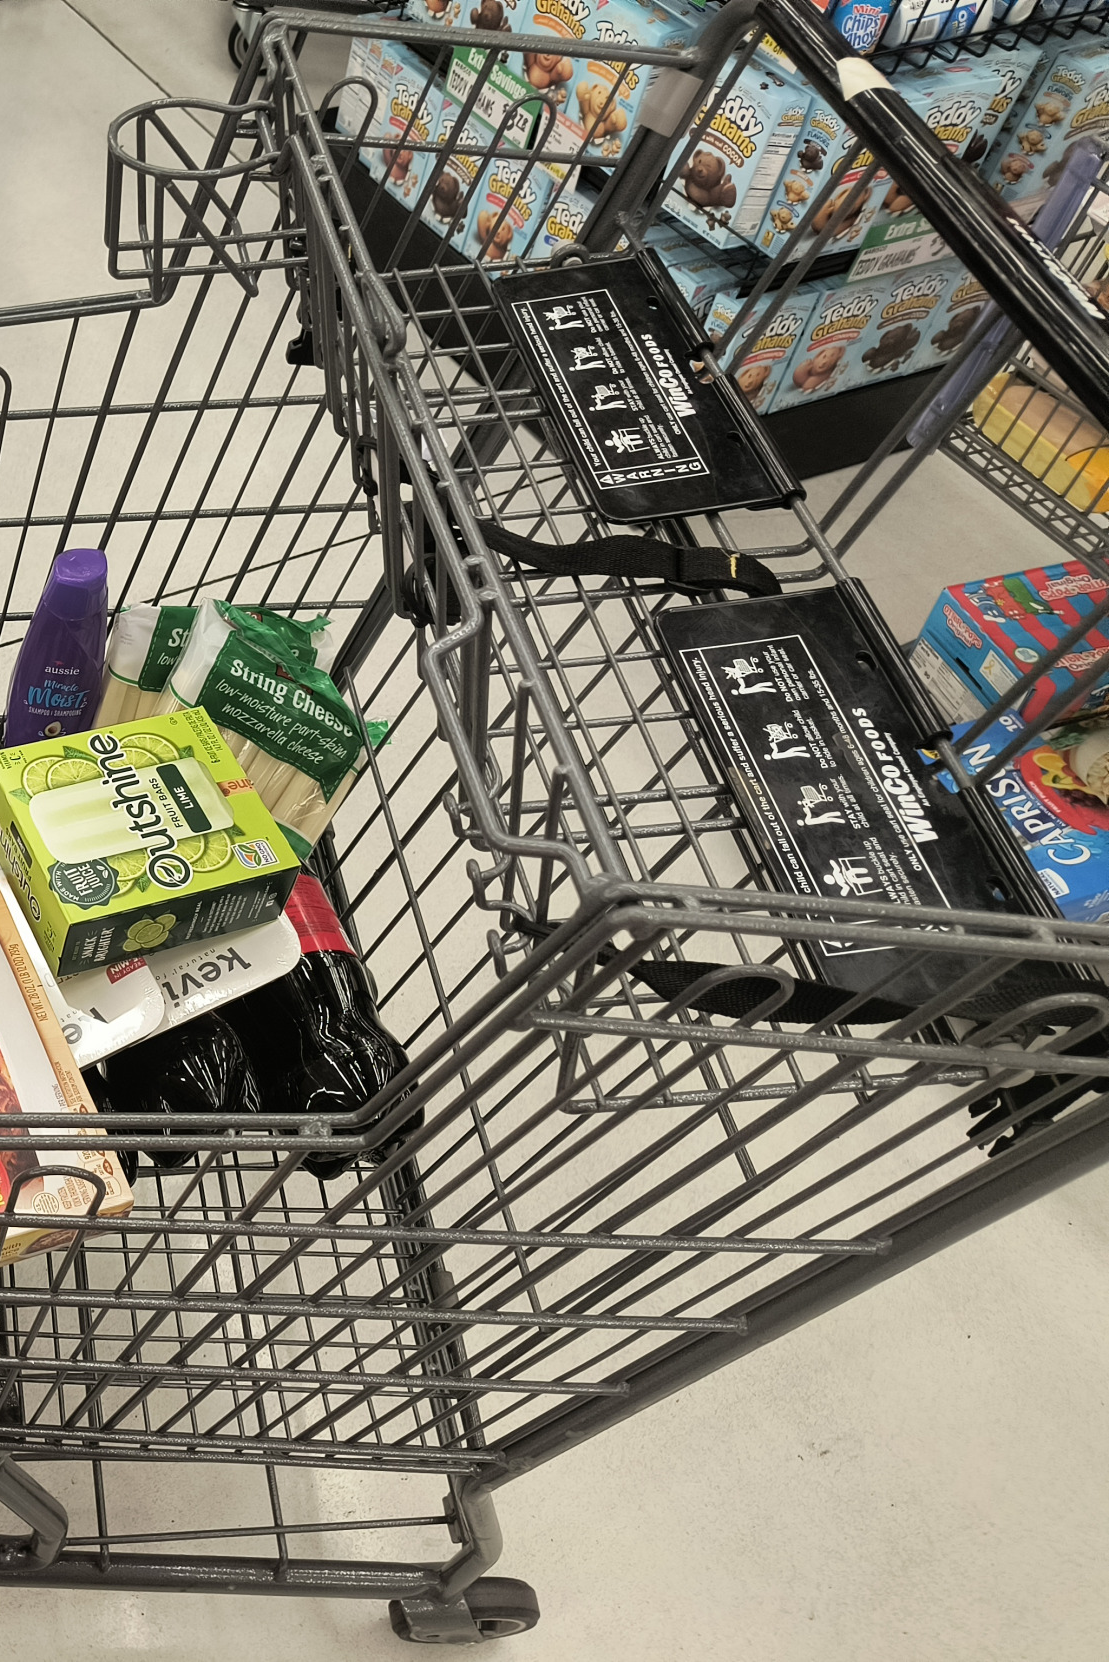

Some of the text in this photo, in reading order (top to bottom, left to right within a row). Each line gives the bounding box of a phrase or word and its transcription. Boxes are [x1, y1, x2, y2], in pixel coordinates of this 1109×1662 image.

[853, 4, 881, 16] Mini
[842, 15, 881, 37] Chips
[1057, 66, 1086, 85] Teddy
[395, 83, 433, 126] Tedy
[926, 100, 982, 129] Teddy
[814, 109, 840, 132] Teddy
[892, 274, 949, 303] Teddy
[821, 295, 878, 325] Teddy
[881, 296, 939, 320] Grahams
[811, 315, 870, 341] Grahams
[639, 333, 669, 368] FOODS
[560, 393, 570, 402] the
[653, 368, 697, 417] WinCo
[576, 427, 587, 438] can
[582, 438, 594, 452] child
[589, 452, 601, 466] Your
[611, 460, 702, 483] WARNING
[45, 666, 80, 675] aussie
[760, 650, 793, 701] Do NOT use your
[44, 680, 79, 692] Miracle
[700, 682, 716, 699] head
[230, 658, 354, 738] String Cheese
[821, 698, 834, 710] and
[28, 706, 50, 716] SHAMPOO
[215, 678, 348, 759] low-moisture part-skim
[710, 701, 731, 730] serious
[828, 711, 847, 733] months
[222, 702, 325, 765] mozzarella cheese
[998, 715, 1020, 733] 10
[727, 737, 746, 760] suffer
[791, 709, 828, 768] Do NOT allow child
[849, 749, 866, 765] ages
[739, 762, 754, 777] and
[850, 706, 939, 843] WinCo FOODS
[859, 766, 879, 792] children
[173, 785, 194, 810] LIME
[748, 778, 763, 795] cart
[149, 777, 184, 828] FRUIT BARS
[756, 796, 770, 810] the
[827, 777, 861, 829] STAY with your
[835, 773, 870, 827] child at all times.
[873, 793, 885, 803] for
[89, 733, 193, 889] Outshine
[763, 810, 775, 820] of
[879, 803, 893, 818] seat
[769, 822, 783, 836] out
[888, 819, 902, 833] cart
[777, 838, 791, 851] fall
[868, 836, 881, 850] and
[896, 834, 909, 847] use
[784, 853, 800, 869] can
[876, 851, 890, 867] seat
[903, 848, 922, 871] ONLY
[64, 869, 92, 897] FRUIT
[79, 863, 104, 890] JUICE
[793, 871, 811, 893] child
[861, 840, 901, 905] LWAYS buckle up
[885, 867, 899, 882] cart
[55, 870, 79, 902] MADE WITH
[79, 933, 99, 961] SNACK
